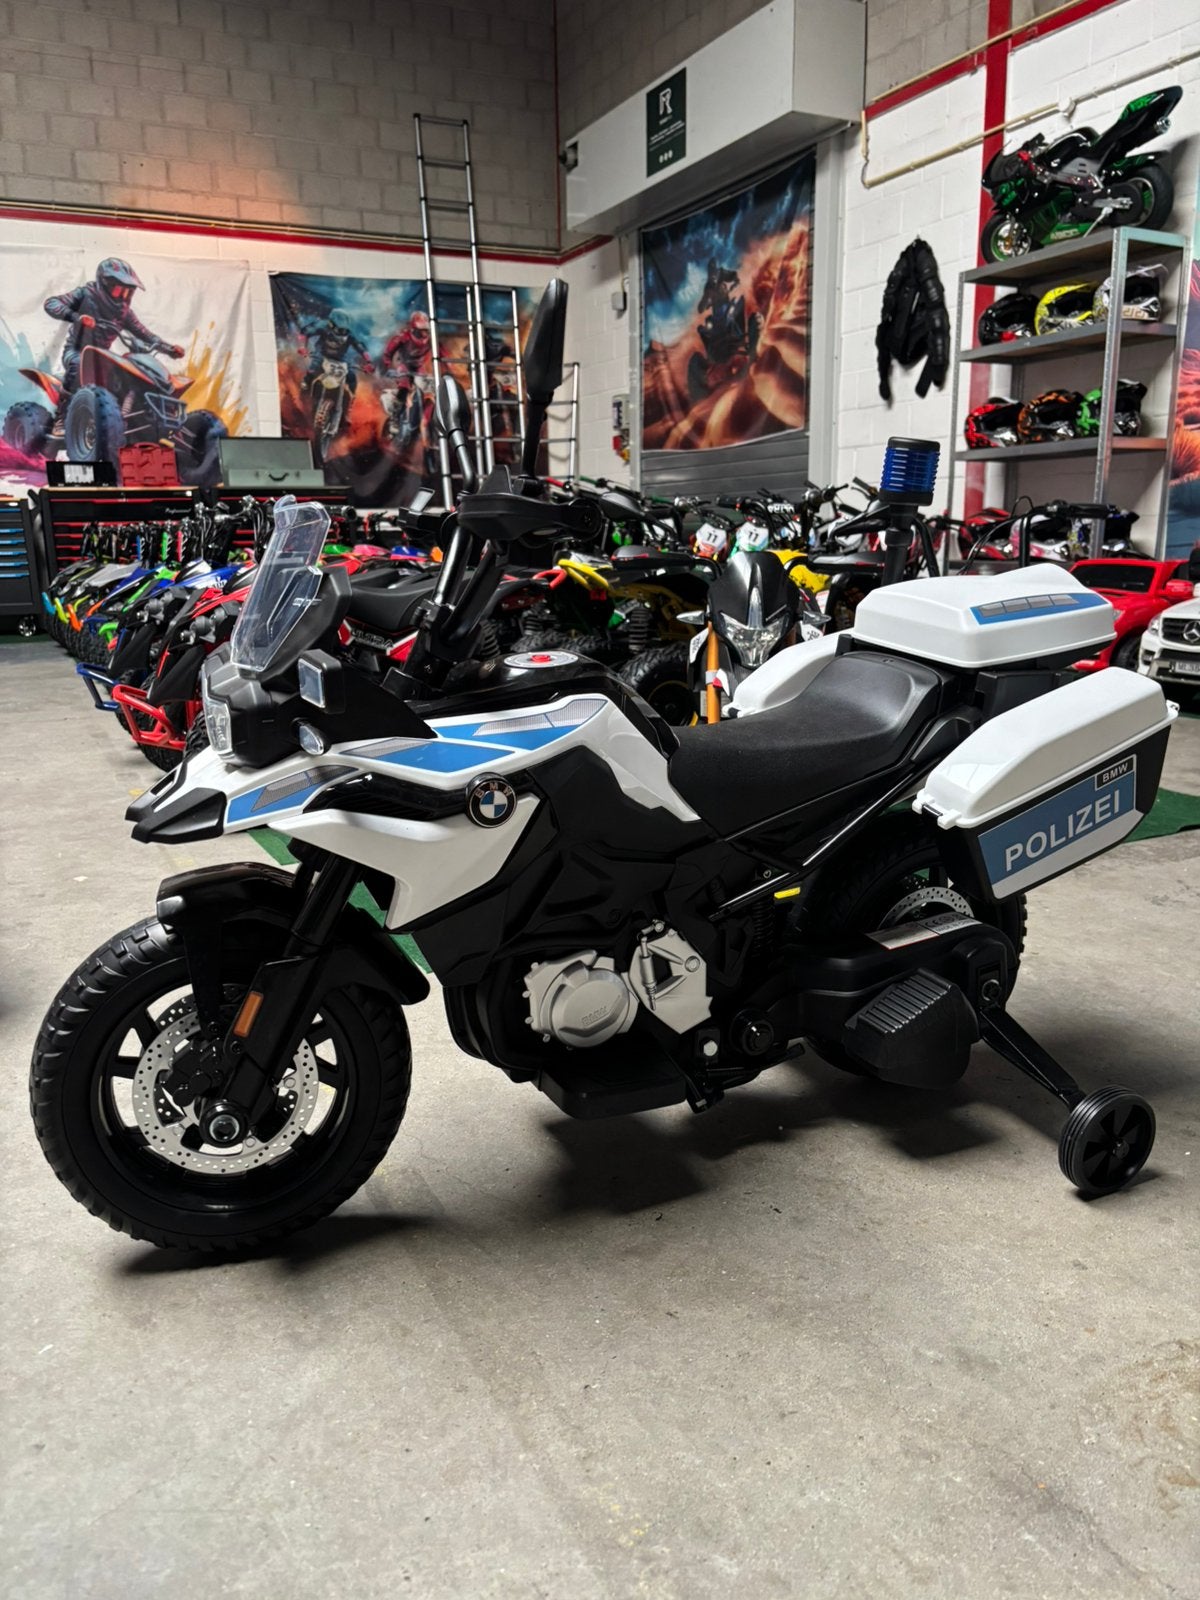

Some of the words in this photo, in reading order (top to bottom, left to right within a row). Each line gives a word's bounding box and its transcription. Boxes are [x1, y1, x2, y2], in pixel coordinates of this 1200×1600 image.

[707, 532, 718, 543] 11
[748, 530, 759, 542] 11
[1102, 763, 1129, 783] BMW
[474, 782, 513, 799] BMW
[1005, 789, 1119, 872] POLIZEI
